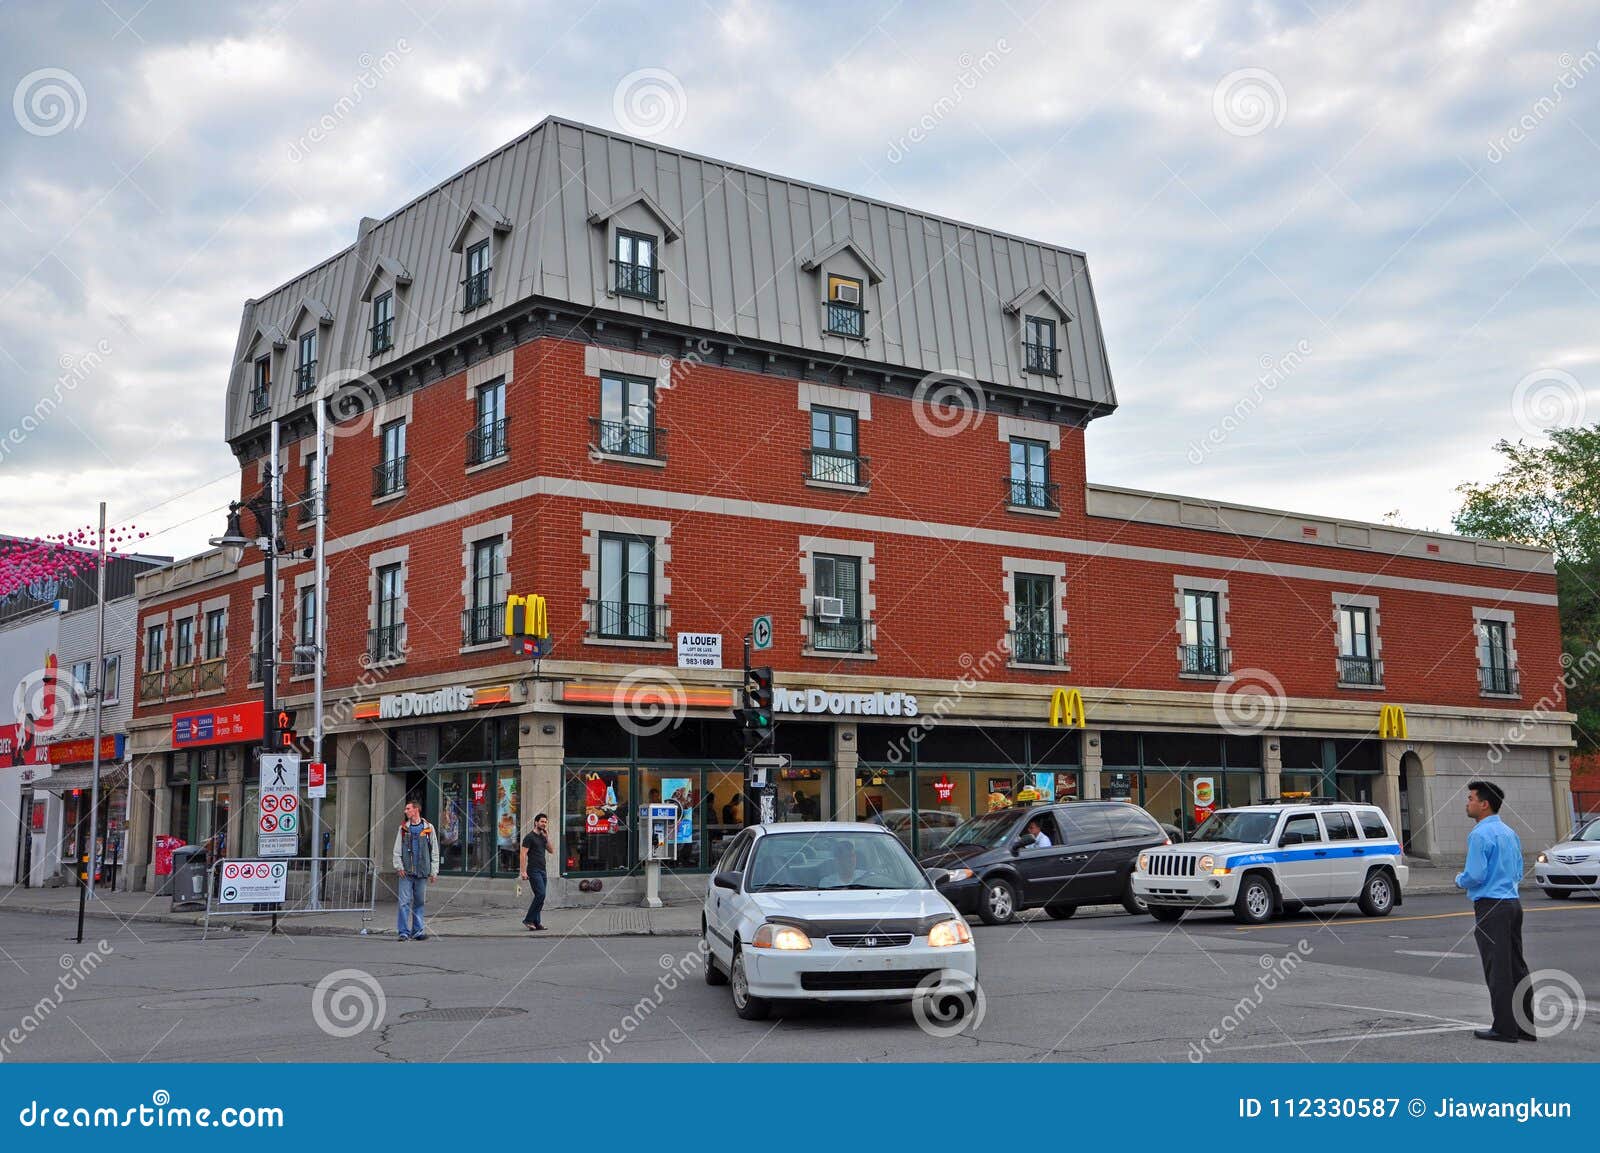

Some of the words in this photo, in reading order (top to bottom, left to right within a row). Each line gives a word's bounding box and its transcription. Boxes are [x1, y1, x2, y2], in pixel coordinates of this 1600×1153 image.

[682, 635, 688, 645] A
[690, 636, 717, 646] LOUER
[380, 686, 474, 719] McDonald's
[772, 688, 919, 717] McDonald's
